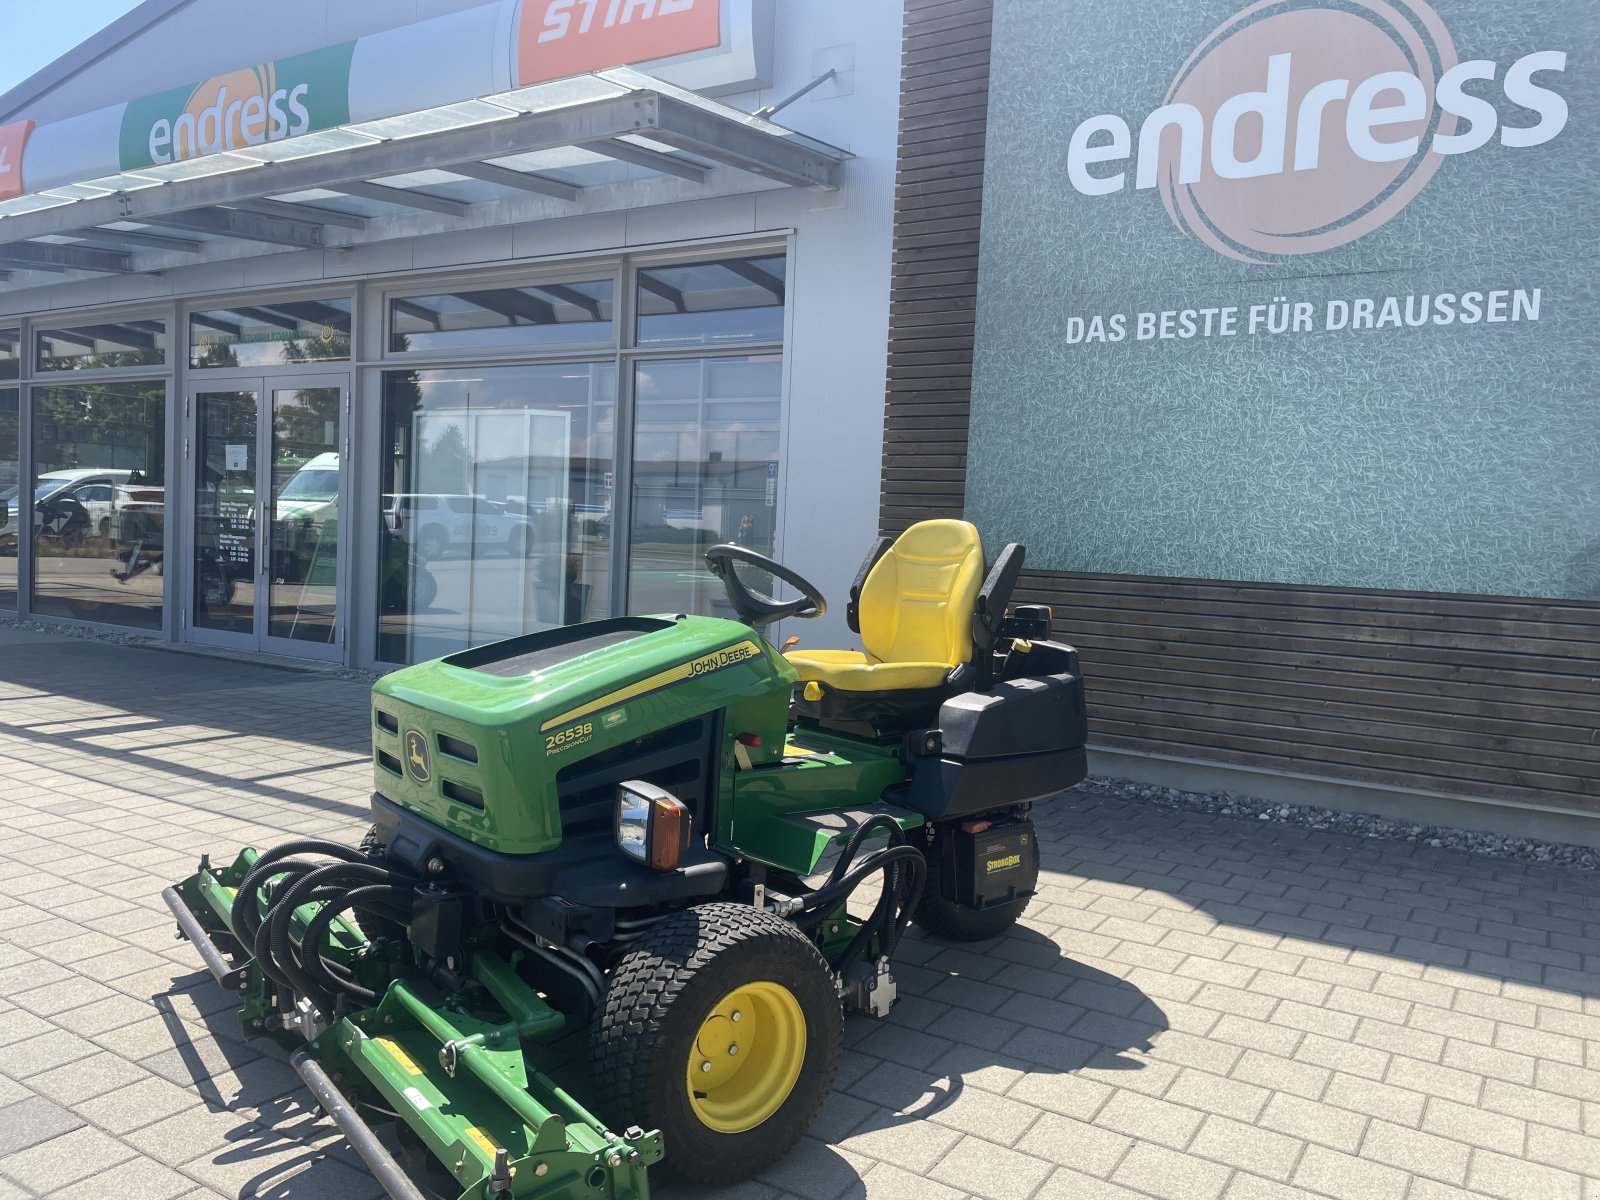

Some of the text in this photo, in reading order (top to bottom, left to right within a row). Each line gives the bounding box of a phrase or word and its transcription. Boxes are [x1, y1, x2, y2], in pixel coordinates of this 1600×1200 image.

[149, 83, 309, 165] endress
[1067, 51, 1568, 196] endress
[1066, 288, 1541, 344] DAS BESTE FÜR DRAUSSEN
[688, 646, 752, 677] JOHN DEERE
[545, 722, 593, 750] 2653B
